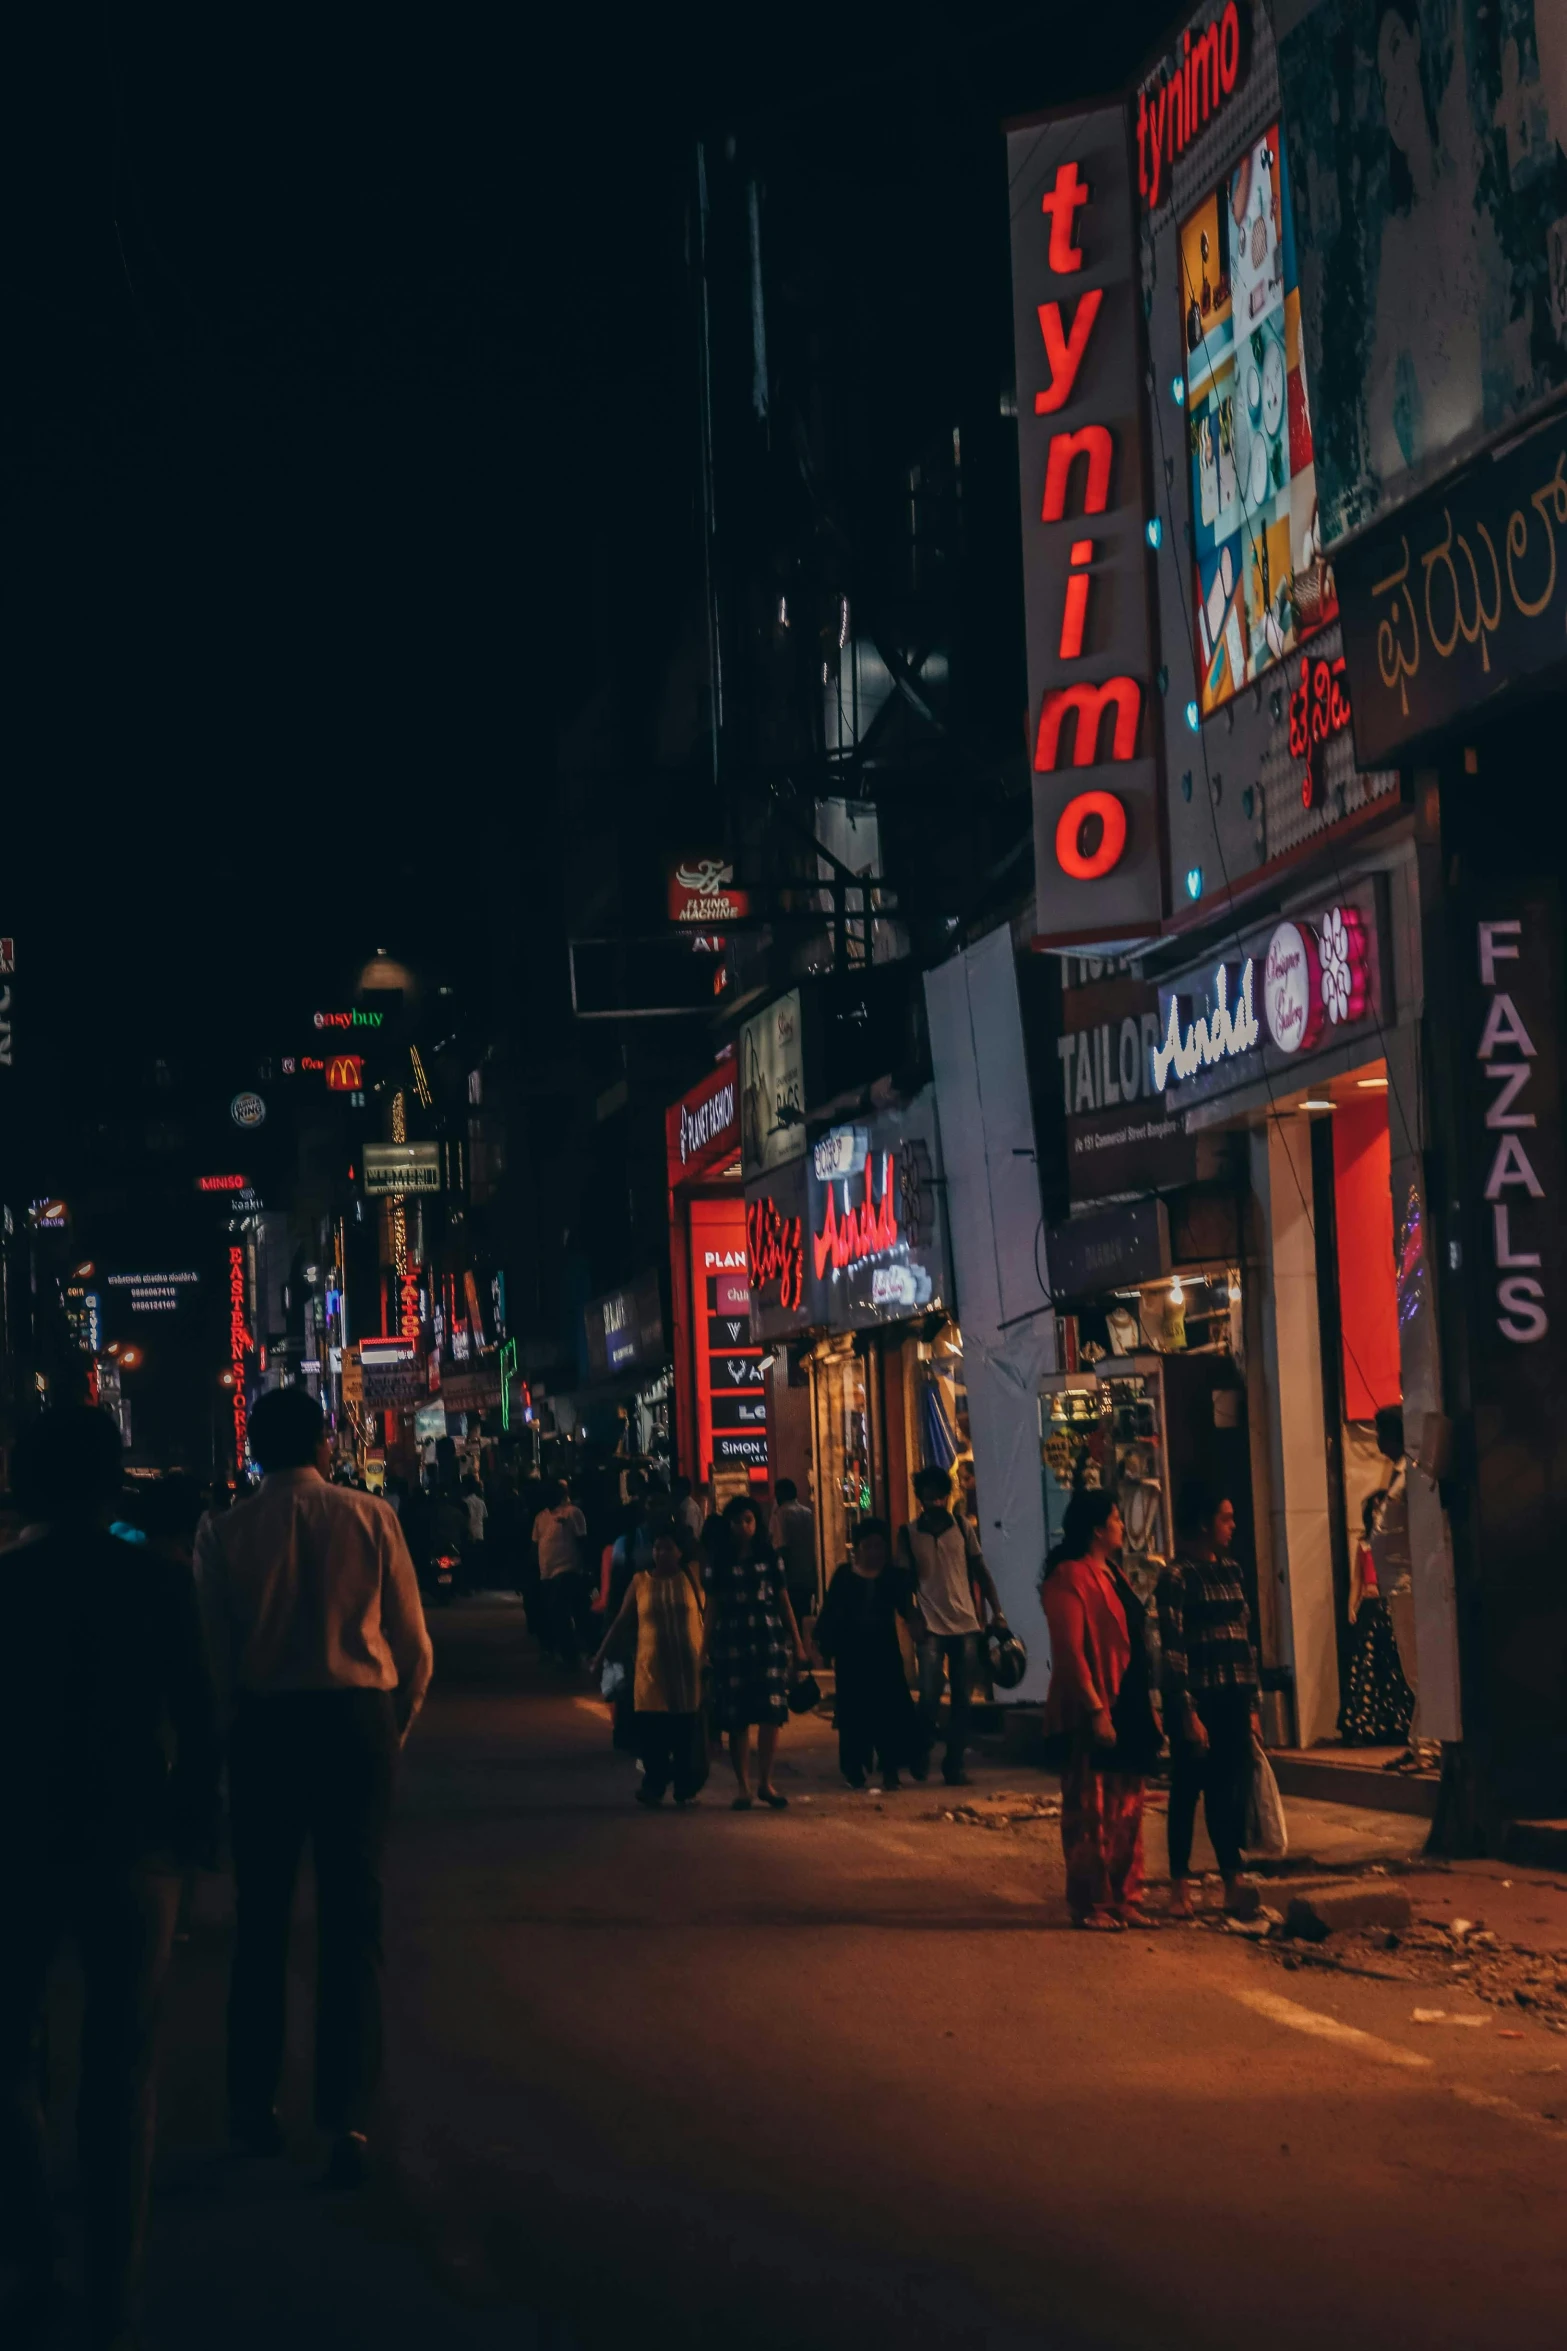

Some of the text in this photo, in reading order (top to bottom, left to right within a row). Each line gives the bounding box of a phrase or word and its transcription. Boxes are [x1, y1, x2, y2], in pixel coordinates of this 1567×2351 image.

[1136, 1, 1239, 209] tynimo
[1034, 161, 1140, 880] tynimo
[686, 898, 730, 909] FLYING
[679, 907, 739, 921] MACHINE
[314, 1007, 384, 1030] easybuy
[1476, 920, 1549, 1343] FAZALS
[201, 1175, 245, 1191] MINISO
[704, 1251, 747, 1268] PLAN
[229, 1246, 245, 1361] EASTERN
[722, 1441, 760, 1456] SIMON
